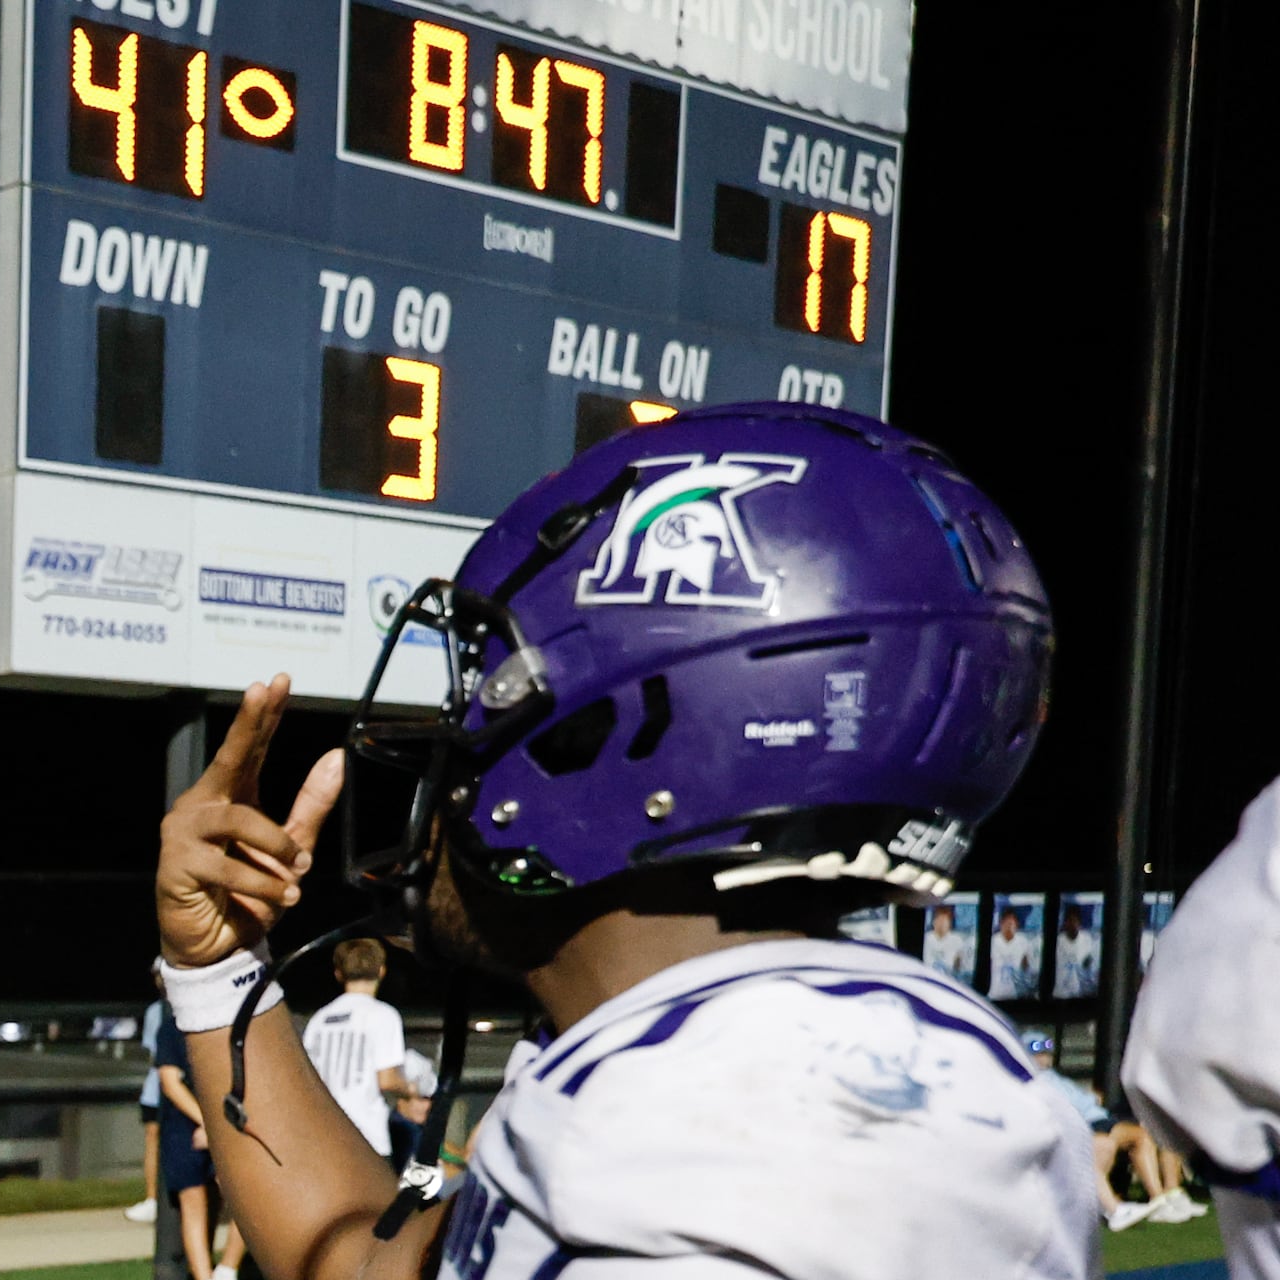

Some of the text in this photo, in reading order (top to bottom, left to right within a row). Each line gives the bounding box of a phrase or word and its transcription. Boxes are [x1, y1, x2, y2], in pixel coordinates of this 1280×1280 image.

[757, 125, 898, 217] EAGLES
[59, 218, 210, 309] DOWN
[804, 210, 873, 344] 17
[318, 269, 452, 354] TO GO
[547, 317, 710, 402] BALL ON
[380, 356, 441, 502] 3
[255, 576, 285, 609] LINE
